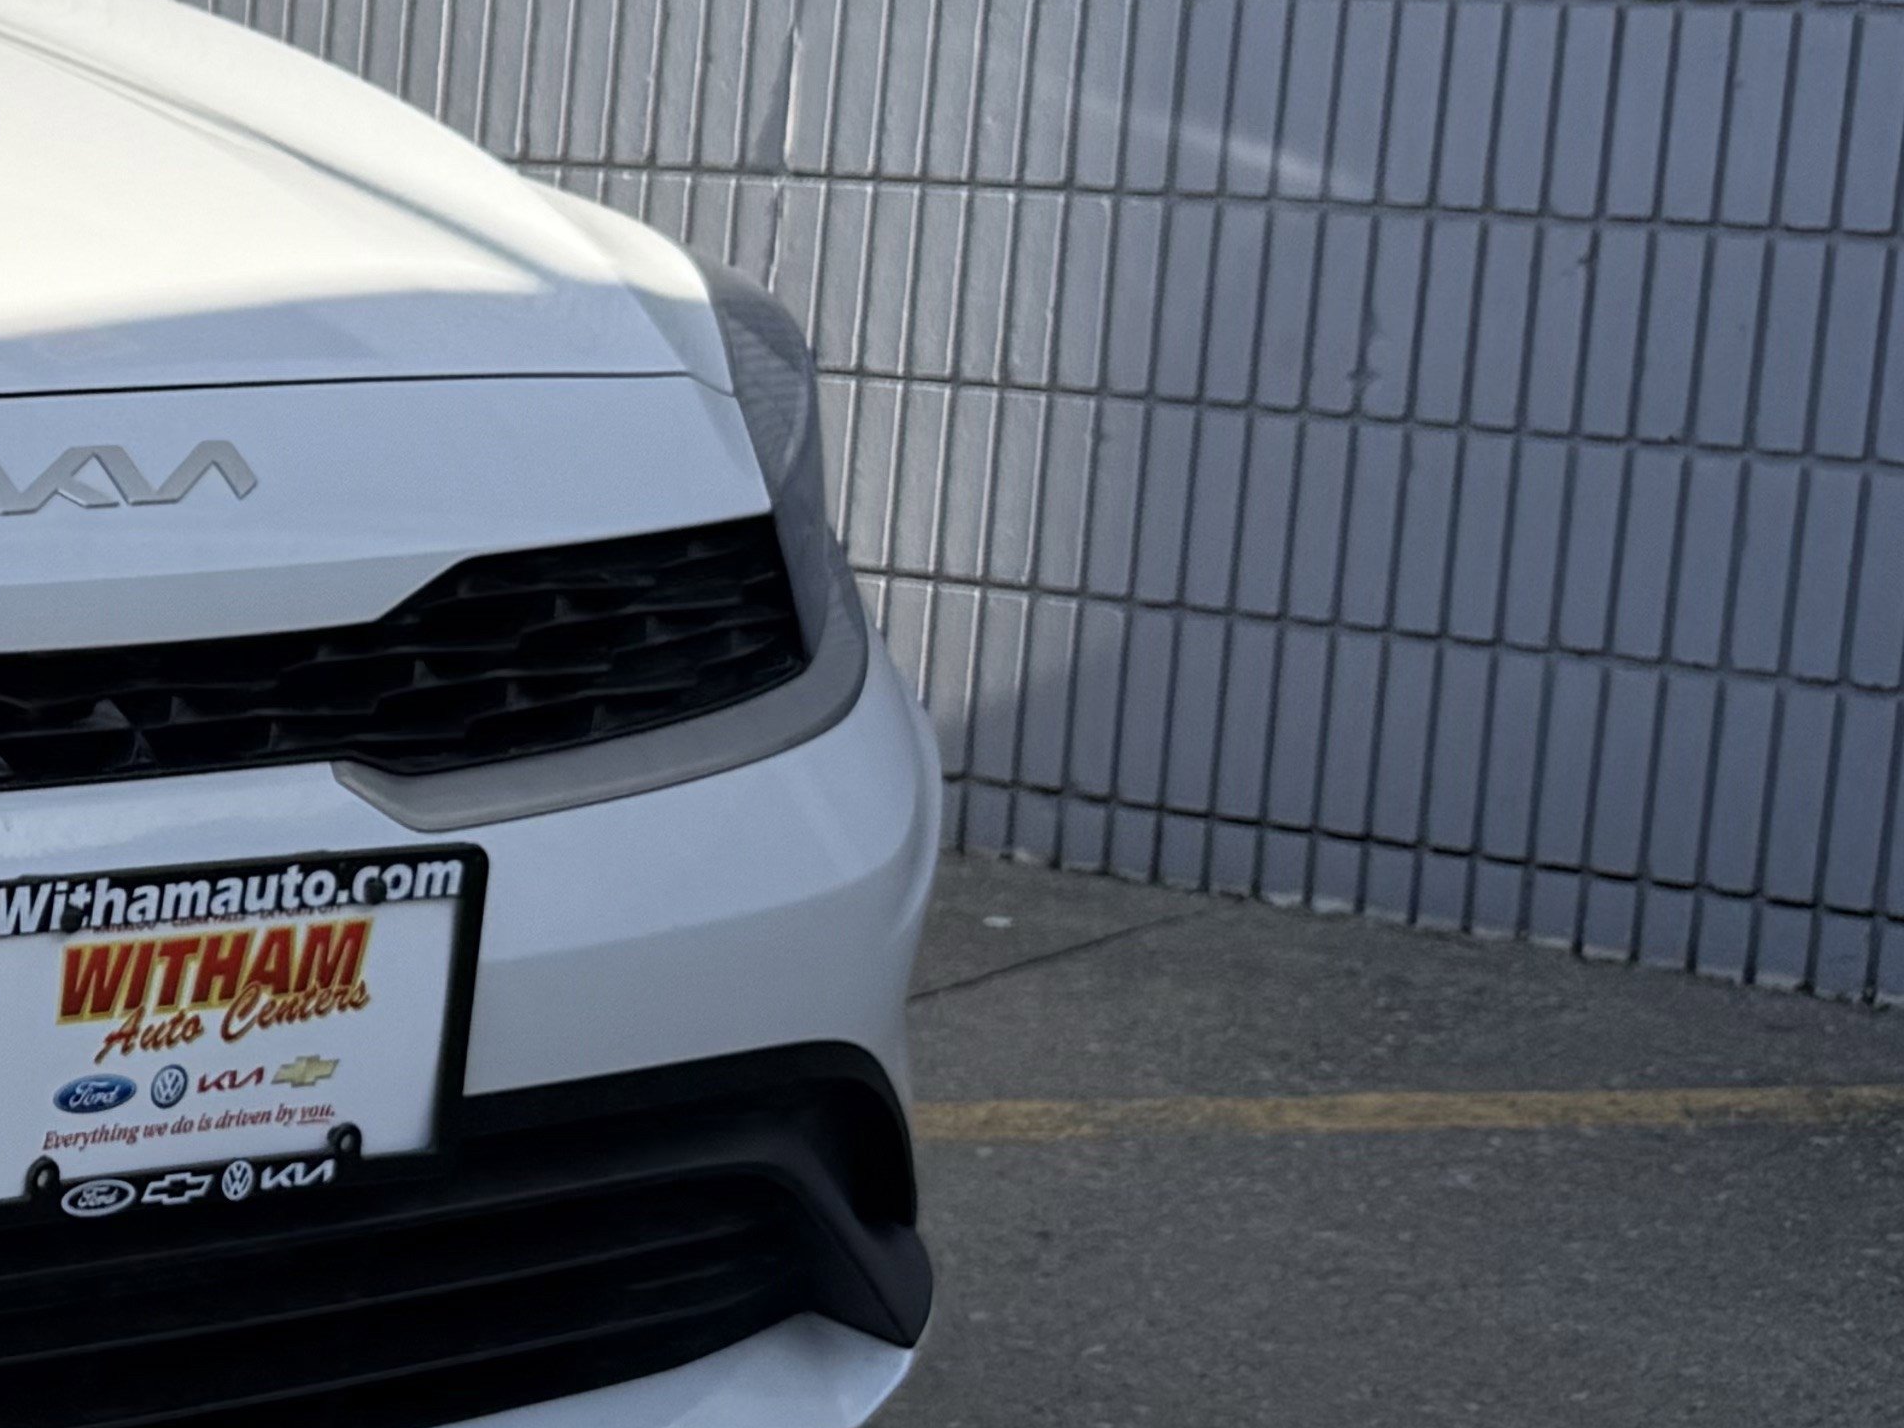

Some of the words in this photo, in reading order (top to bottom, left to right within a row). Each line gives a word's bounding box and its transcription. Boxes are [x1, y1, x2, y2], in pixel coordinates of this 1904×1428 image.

[58, 919, 373, 1022] WITHAM
[95, 1005, 204, 1064] Auto
[220, 978, 370, 1044] Centers
[42, 1123, 141, 1151] Everything
[143, 1123, 165, 1139] we
[170, 1115, 194, 1135] do
[197, 1113, 212, 1132] is
[214, 1108, 272, 1131] driven
[276, 1104, 297, 1126] by
[297, 1103, 336, 1125] you.
[65, 1078, 126, 1110] Ford
